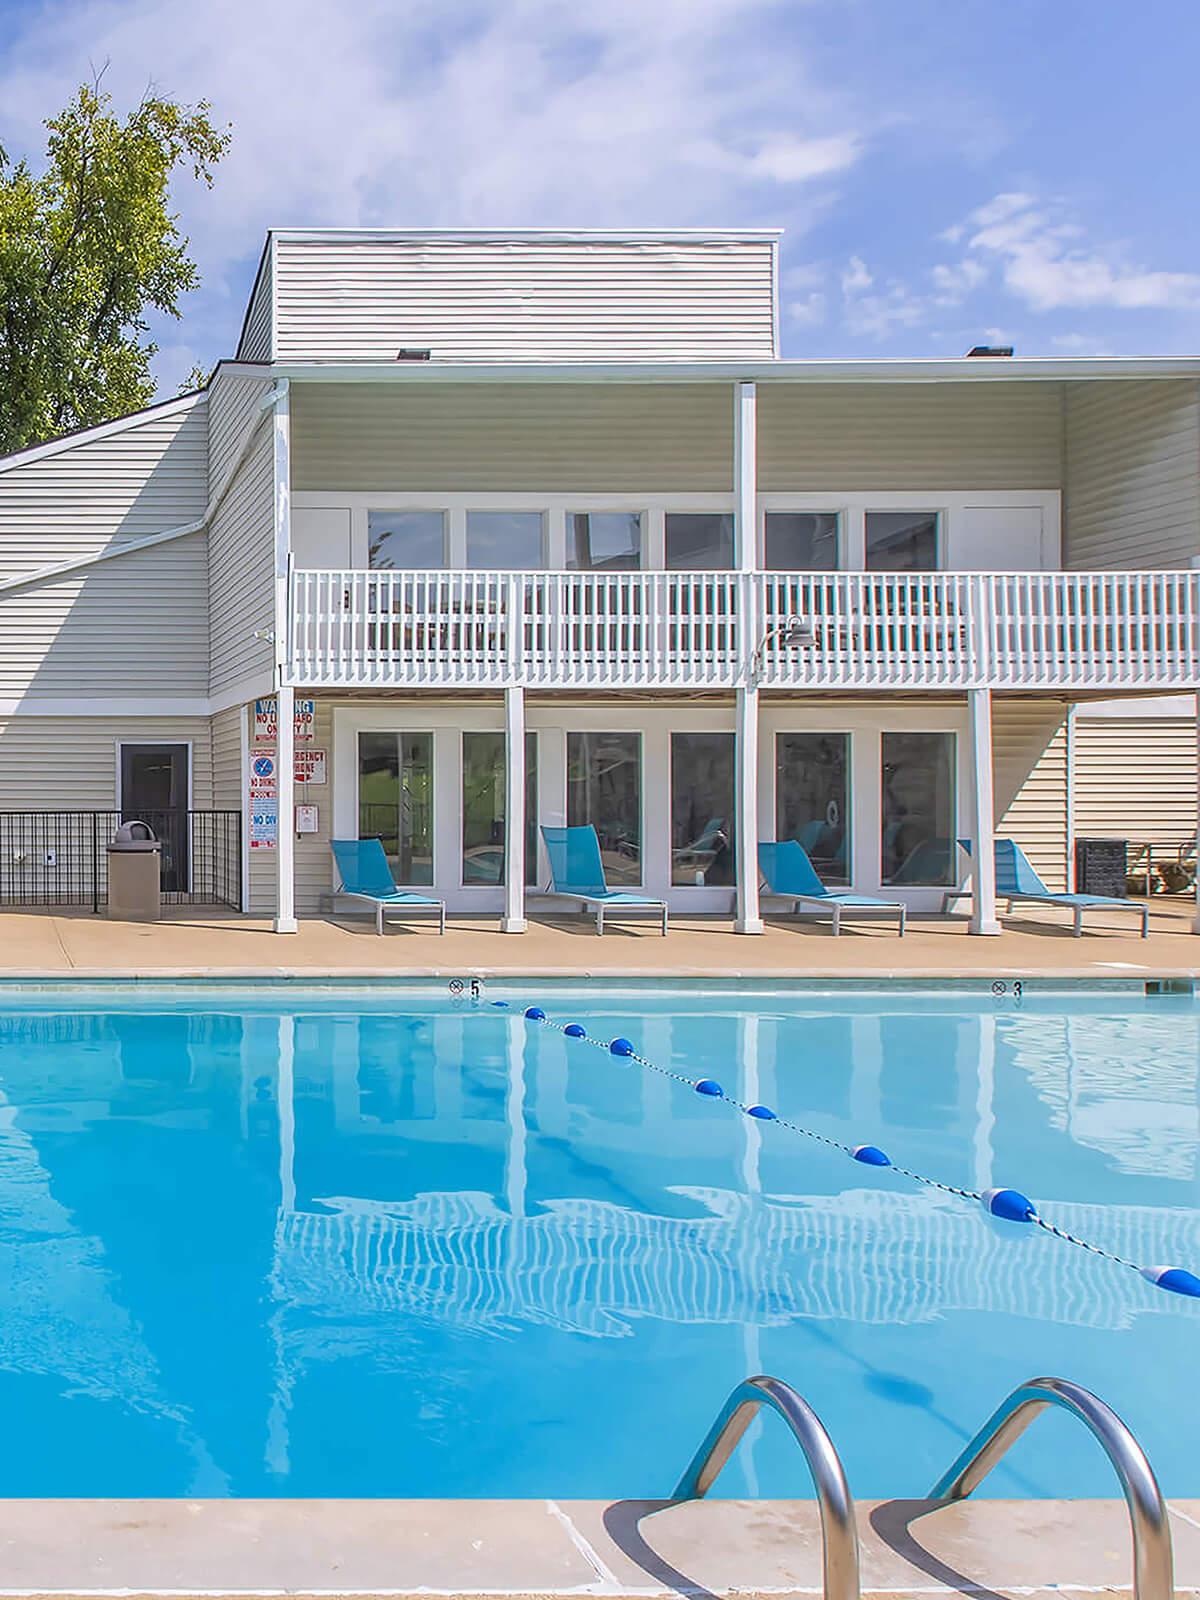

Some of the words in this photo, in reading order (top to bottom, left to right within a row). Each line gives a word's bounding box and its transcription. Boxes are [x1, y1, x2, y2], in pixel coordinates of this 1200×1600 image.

[260, 700, 310, 713] WANG
[256, 714, 268, 723] NO
[254, 815, 264, 824] NO
[471, 980, 479, 996] 5
[1013, 981, 1022, 997] 3
